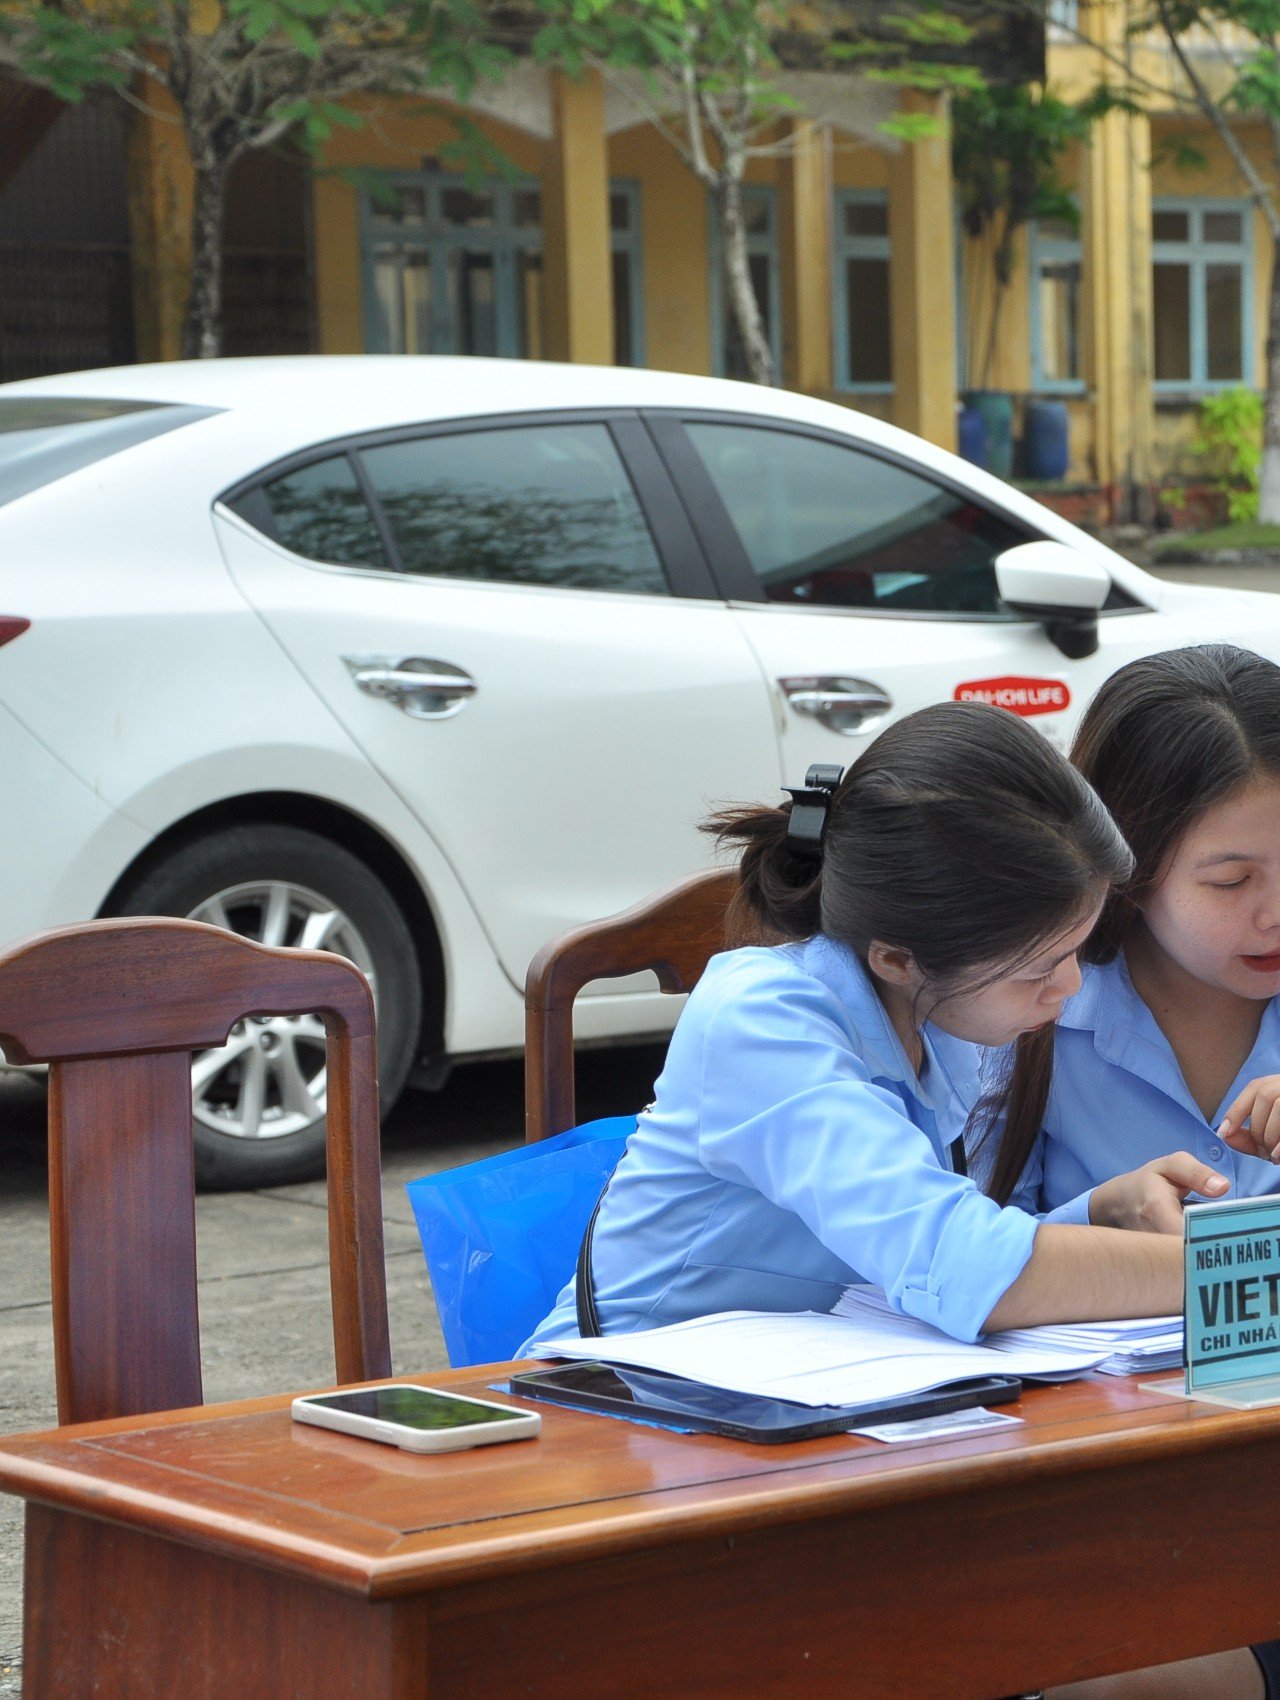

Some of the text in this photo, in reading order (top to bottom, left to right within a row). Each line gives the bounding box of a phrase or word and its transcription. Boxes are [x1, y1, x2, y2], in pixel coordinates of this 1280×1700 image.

[1028, 686, 1065, 706] LIFE
[1196, 1243, 1233, 1271] NGÂN
[1236, 1237, 1272, 1264] HÀNG
[1200, 1334, 1231, 1352] CHI
